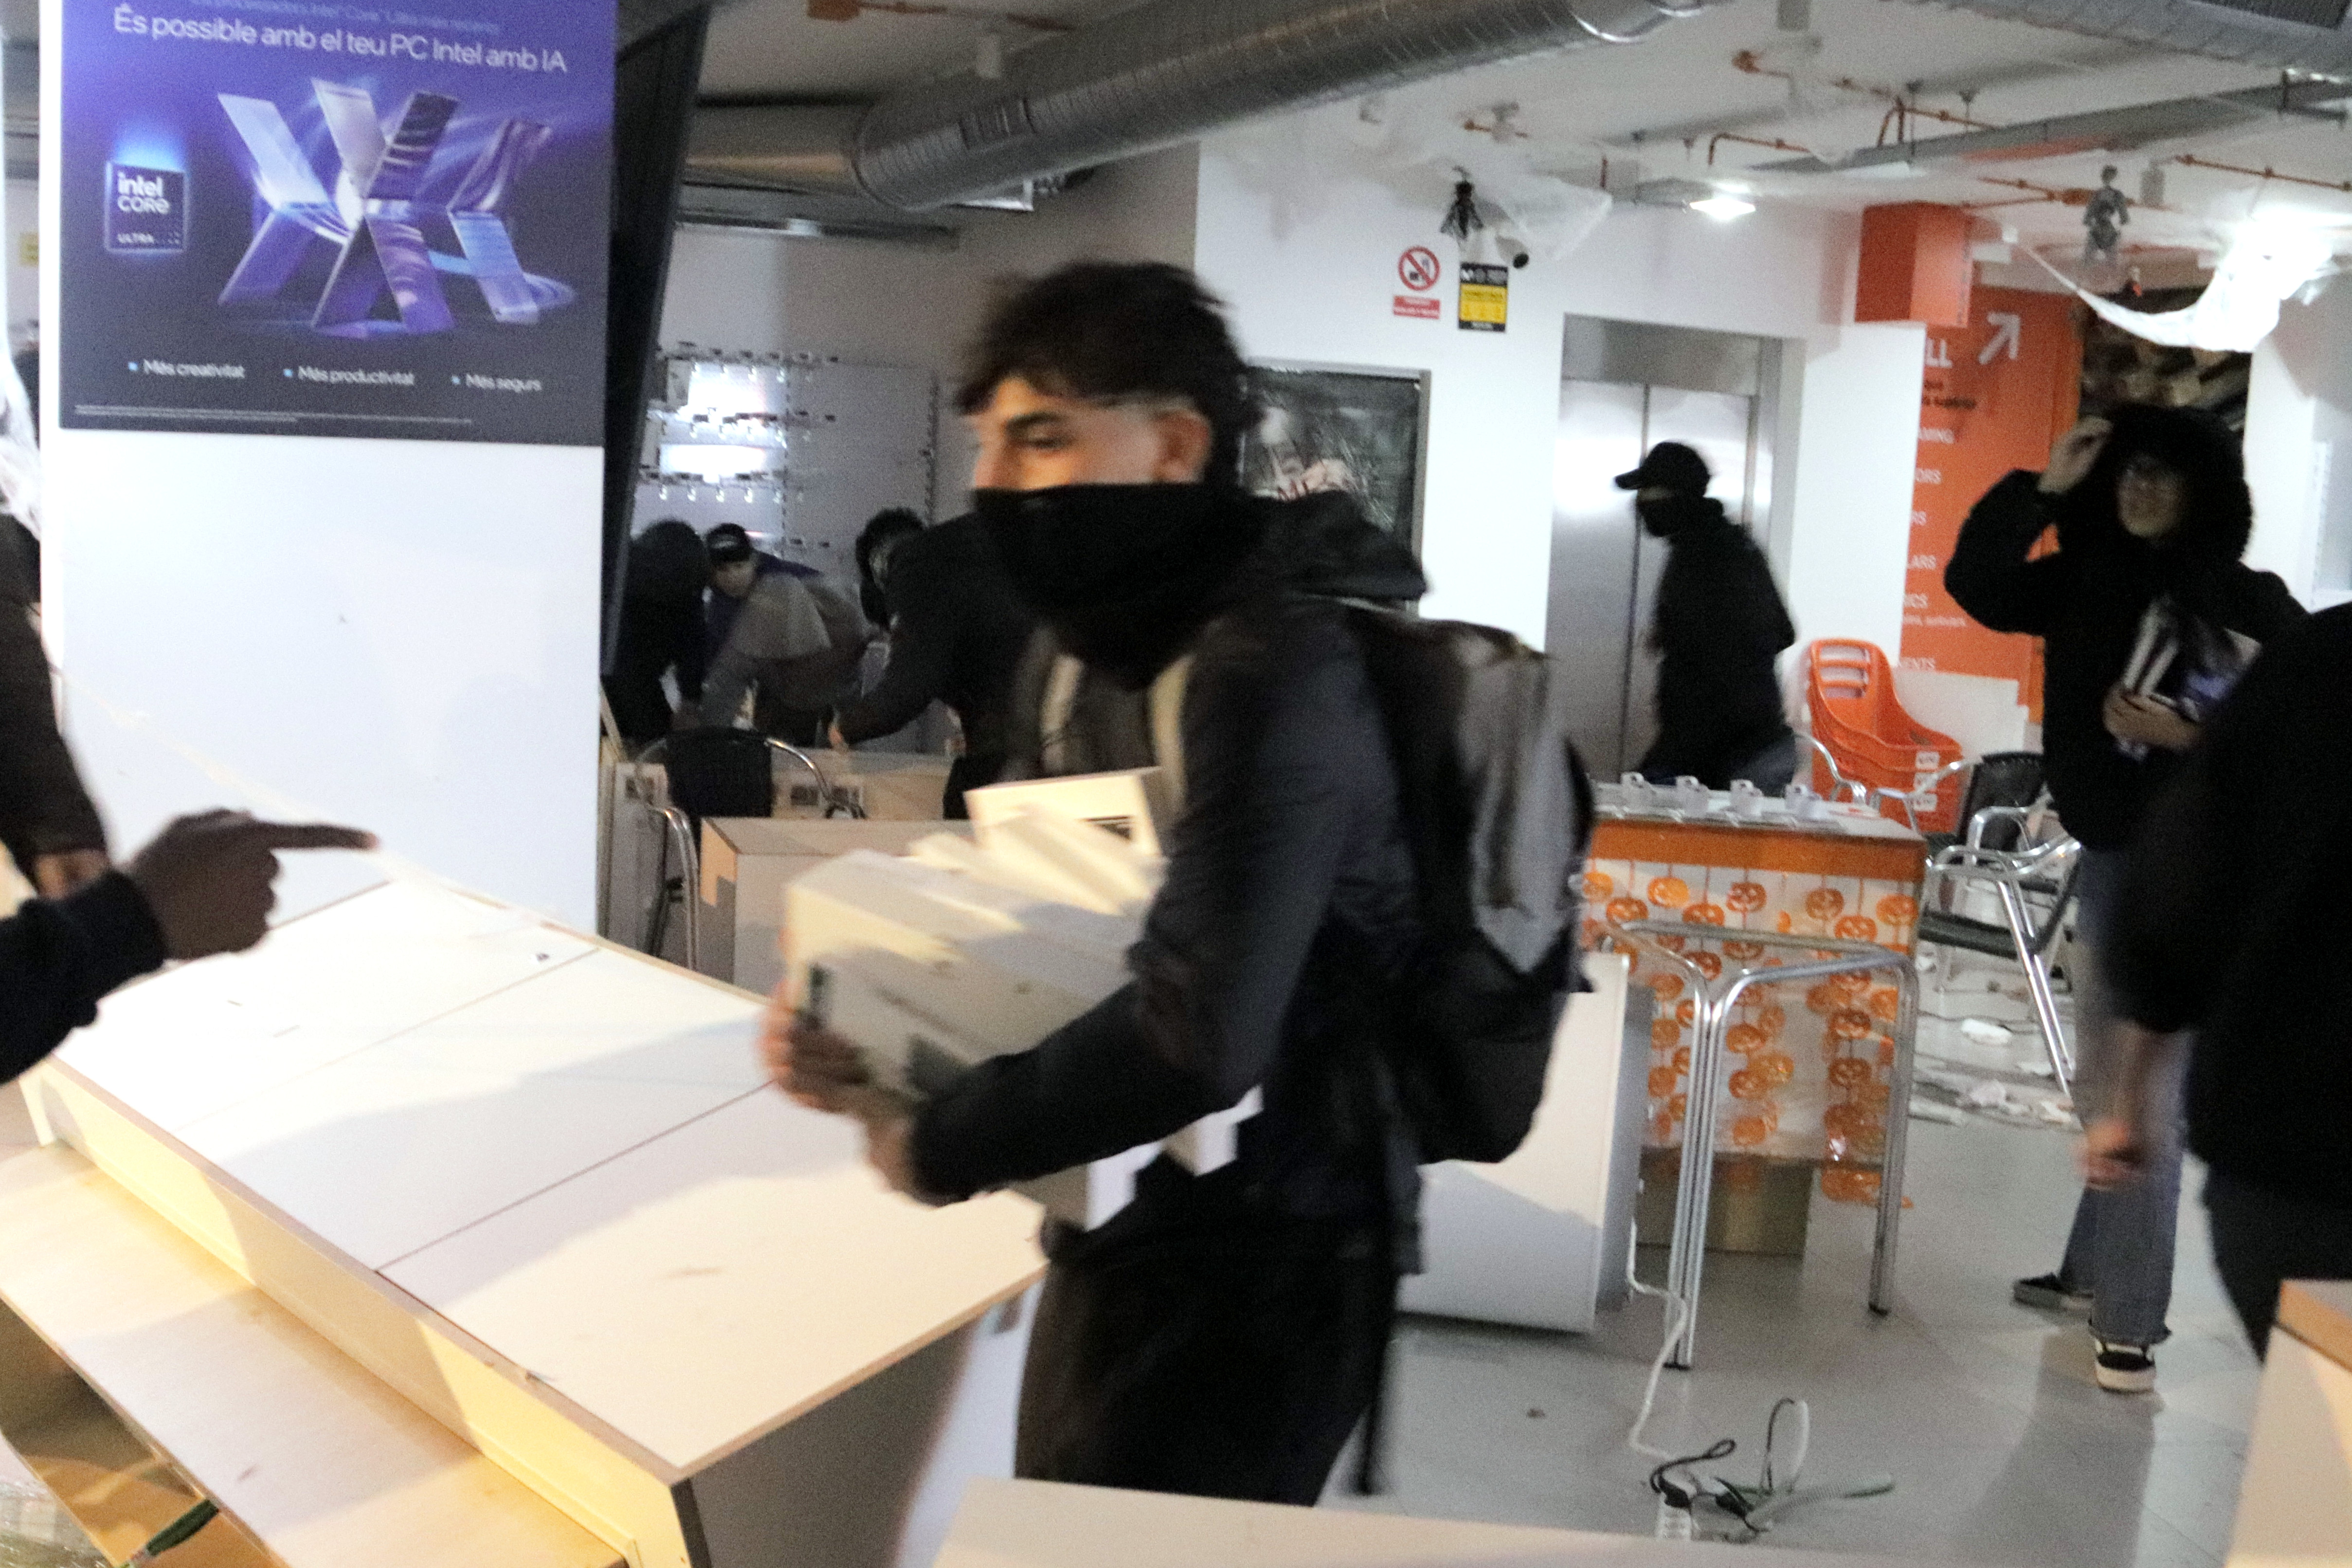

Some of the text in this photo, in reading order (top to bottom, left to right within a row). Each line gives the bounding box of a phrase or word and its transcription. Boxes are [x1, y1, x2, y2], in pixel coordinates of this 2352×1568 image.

[114, 2, 568, 73] És possible amb el teu PC Intel amb IA
[118, 171, 164, 198] intel
